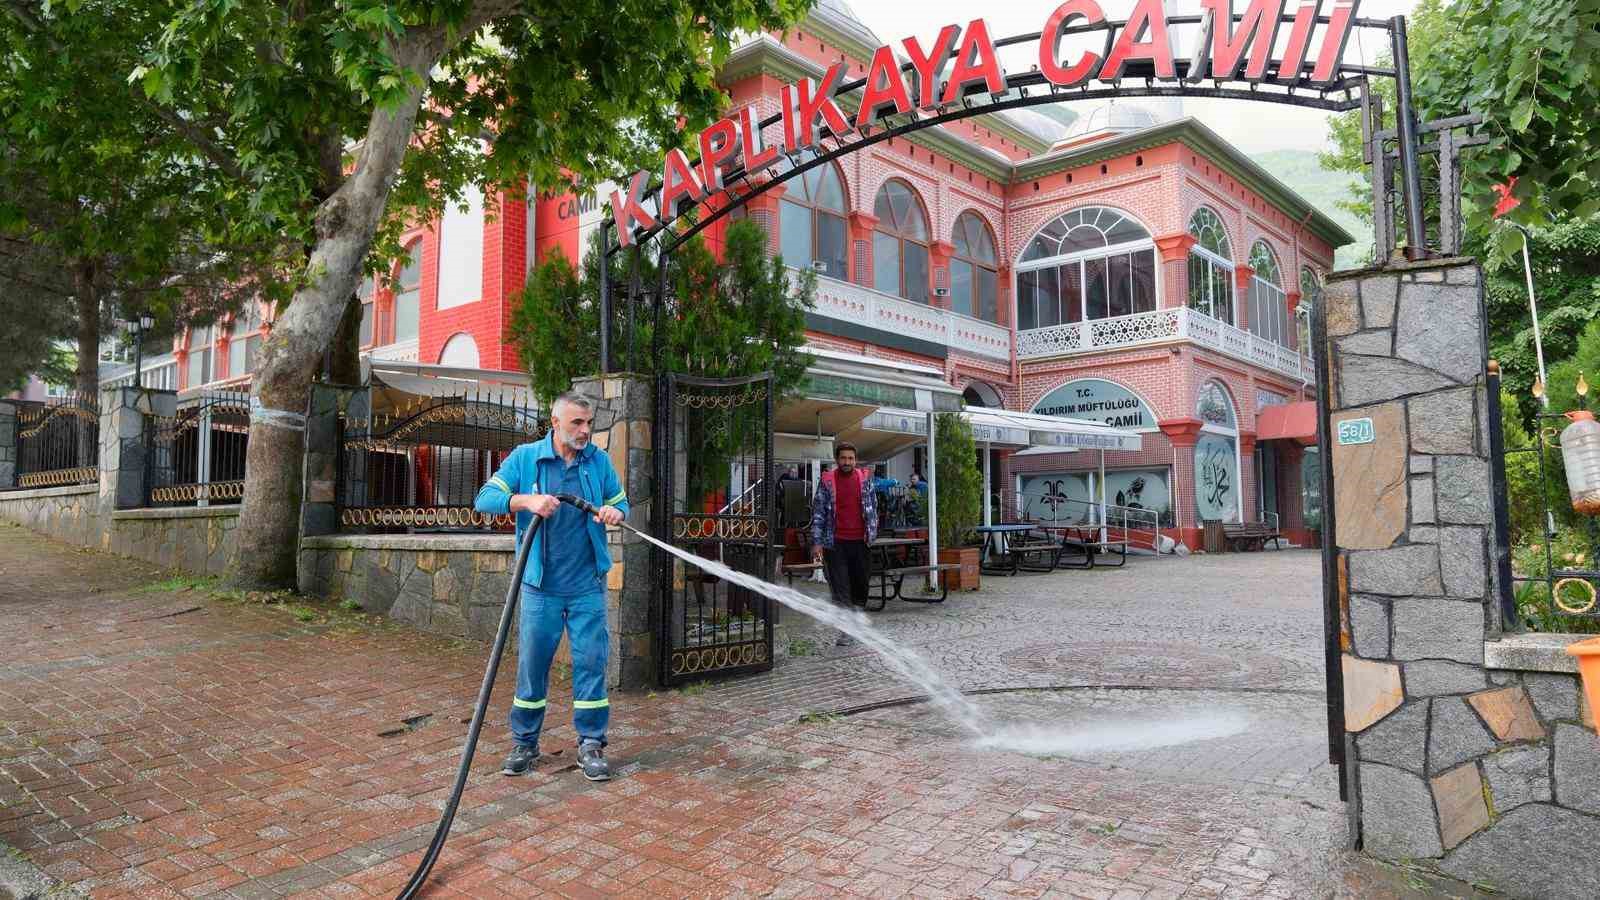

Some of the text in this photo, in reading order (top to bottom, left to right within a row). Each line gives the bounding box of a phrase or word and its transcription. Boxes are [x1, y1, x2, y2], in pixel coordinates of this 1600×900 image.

[610, 18, 1008, 249] KAPLIKAYA
[1076, 388, 1094, 398] T.C.
[1034, 403, 1076, 416] YILDIRIM
